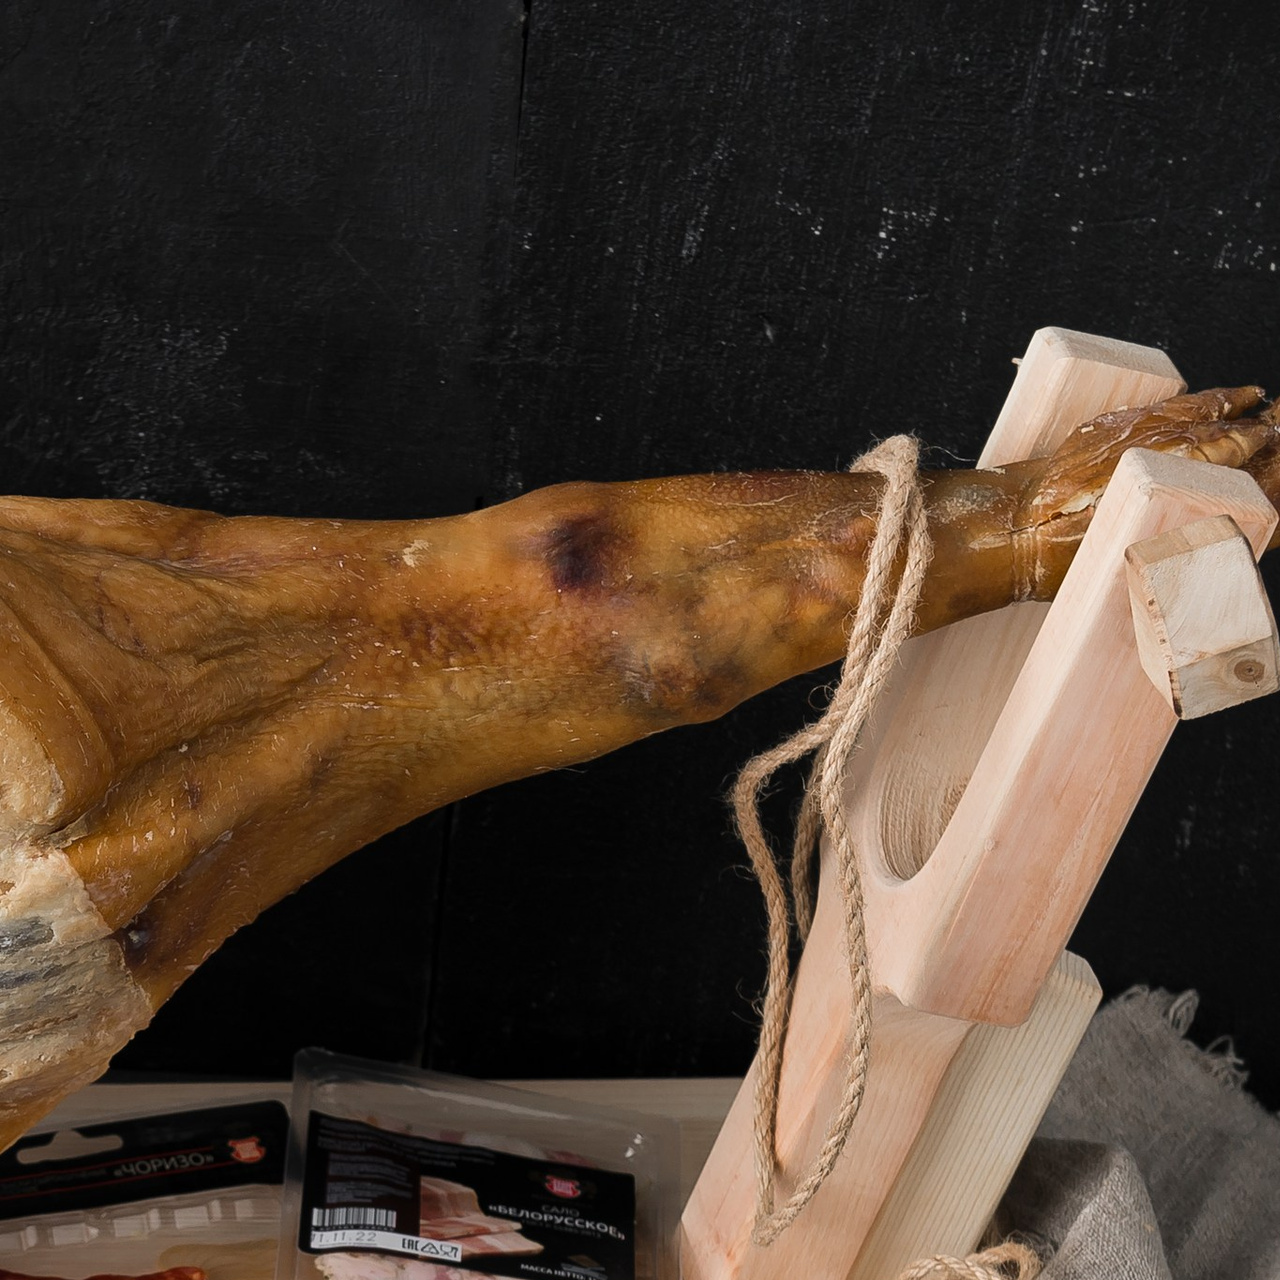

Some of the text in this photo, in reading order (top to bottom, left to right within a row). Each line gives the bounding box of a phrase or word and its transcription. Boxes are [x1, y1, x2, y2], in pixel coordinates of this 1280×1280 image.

[113, 1152, 214, 1177] «ЧОРИЗО»
[541, 1204, 580, 1218] САЛО
[488, 1203, 626, 1241] «БЕЛОРУССКОЕ»
[520, 1264, 553, 1275] МАССА
